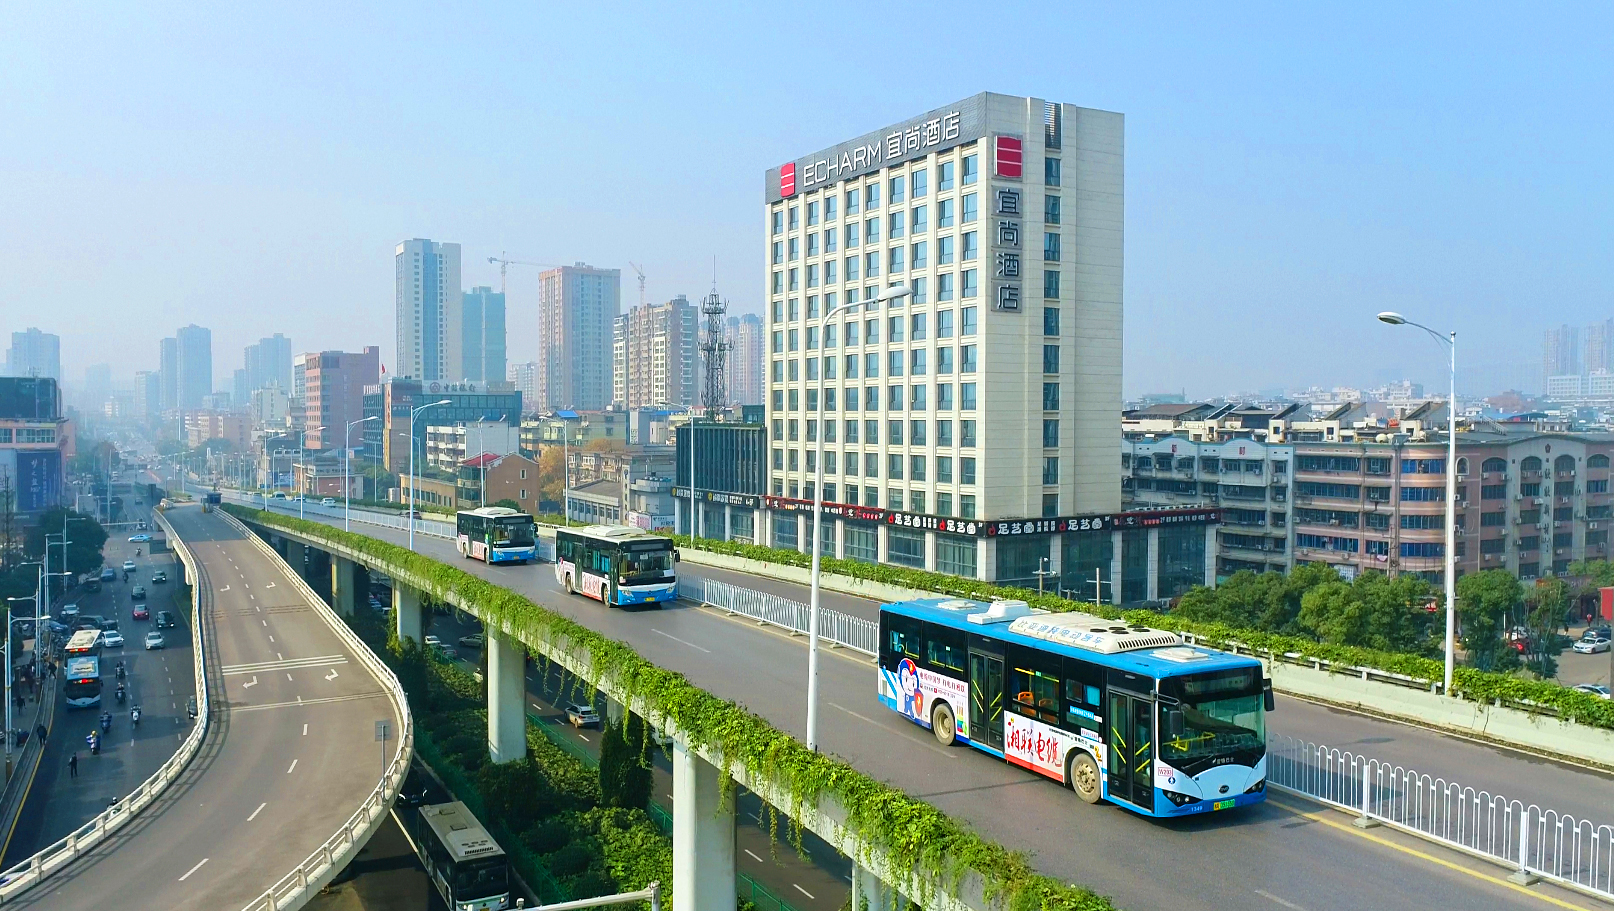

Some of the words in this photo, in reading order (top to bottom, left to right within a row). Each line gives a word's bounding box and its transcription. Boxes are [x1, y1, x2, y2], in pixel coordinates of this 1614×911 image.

[803, 140, 882, 187] ECHARM
[885, 111, 960, 160] 宜尚酒店
[996, 188, 1020, 310] 宜尚酒店
